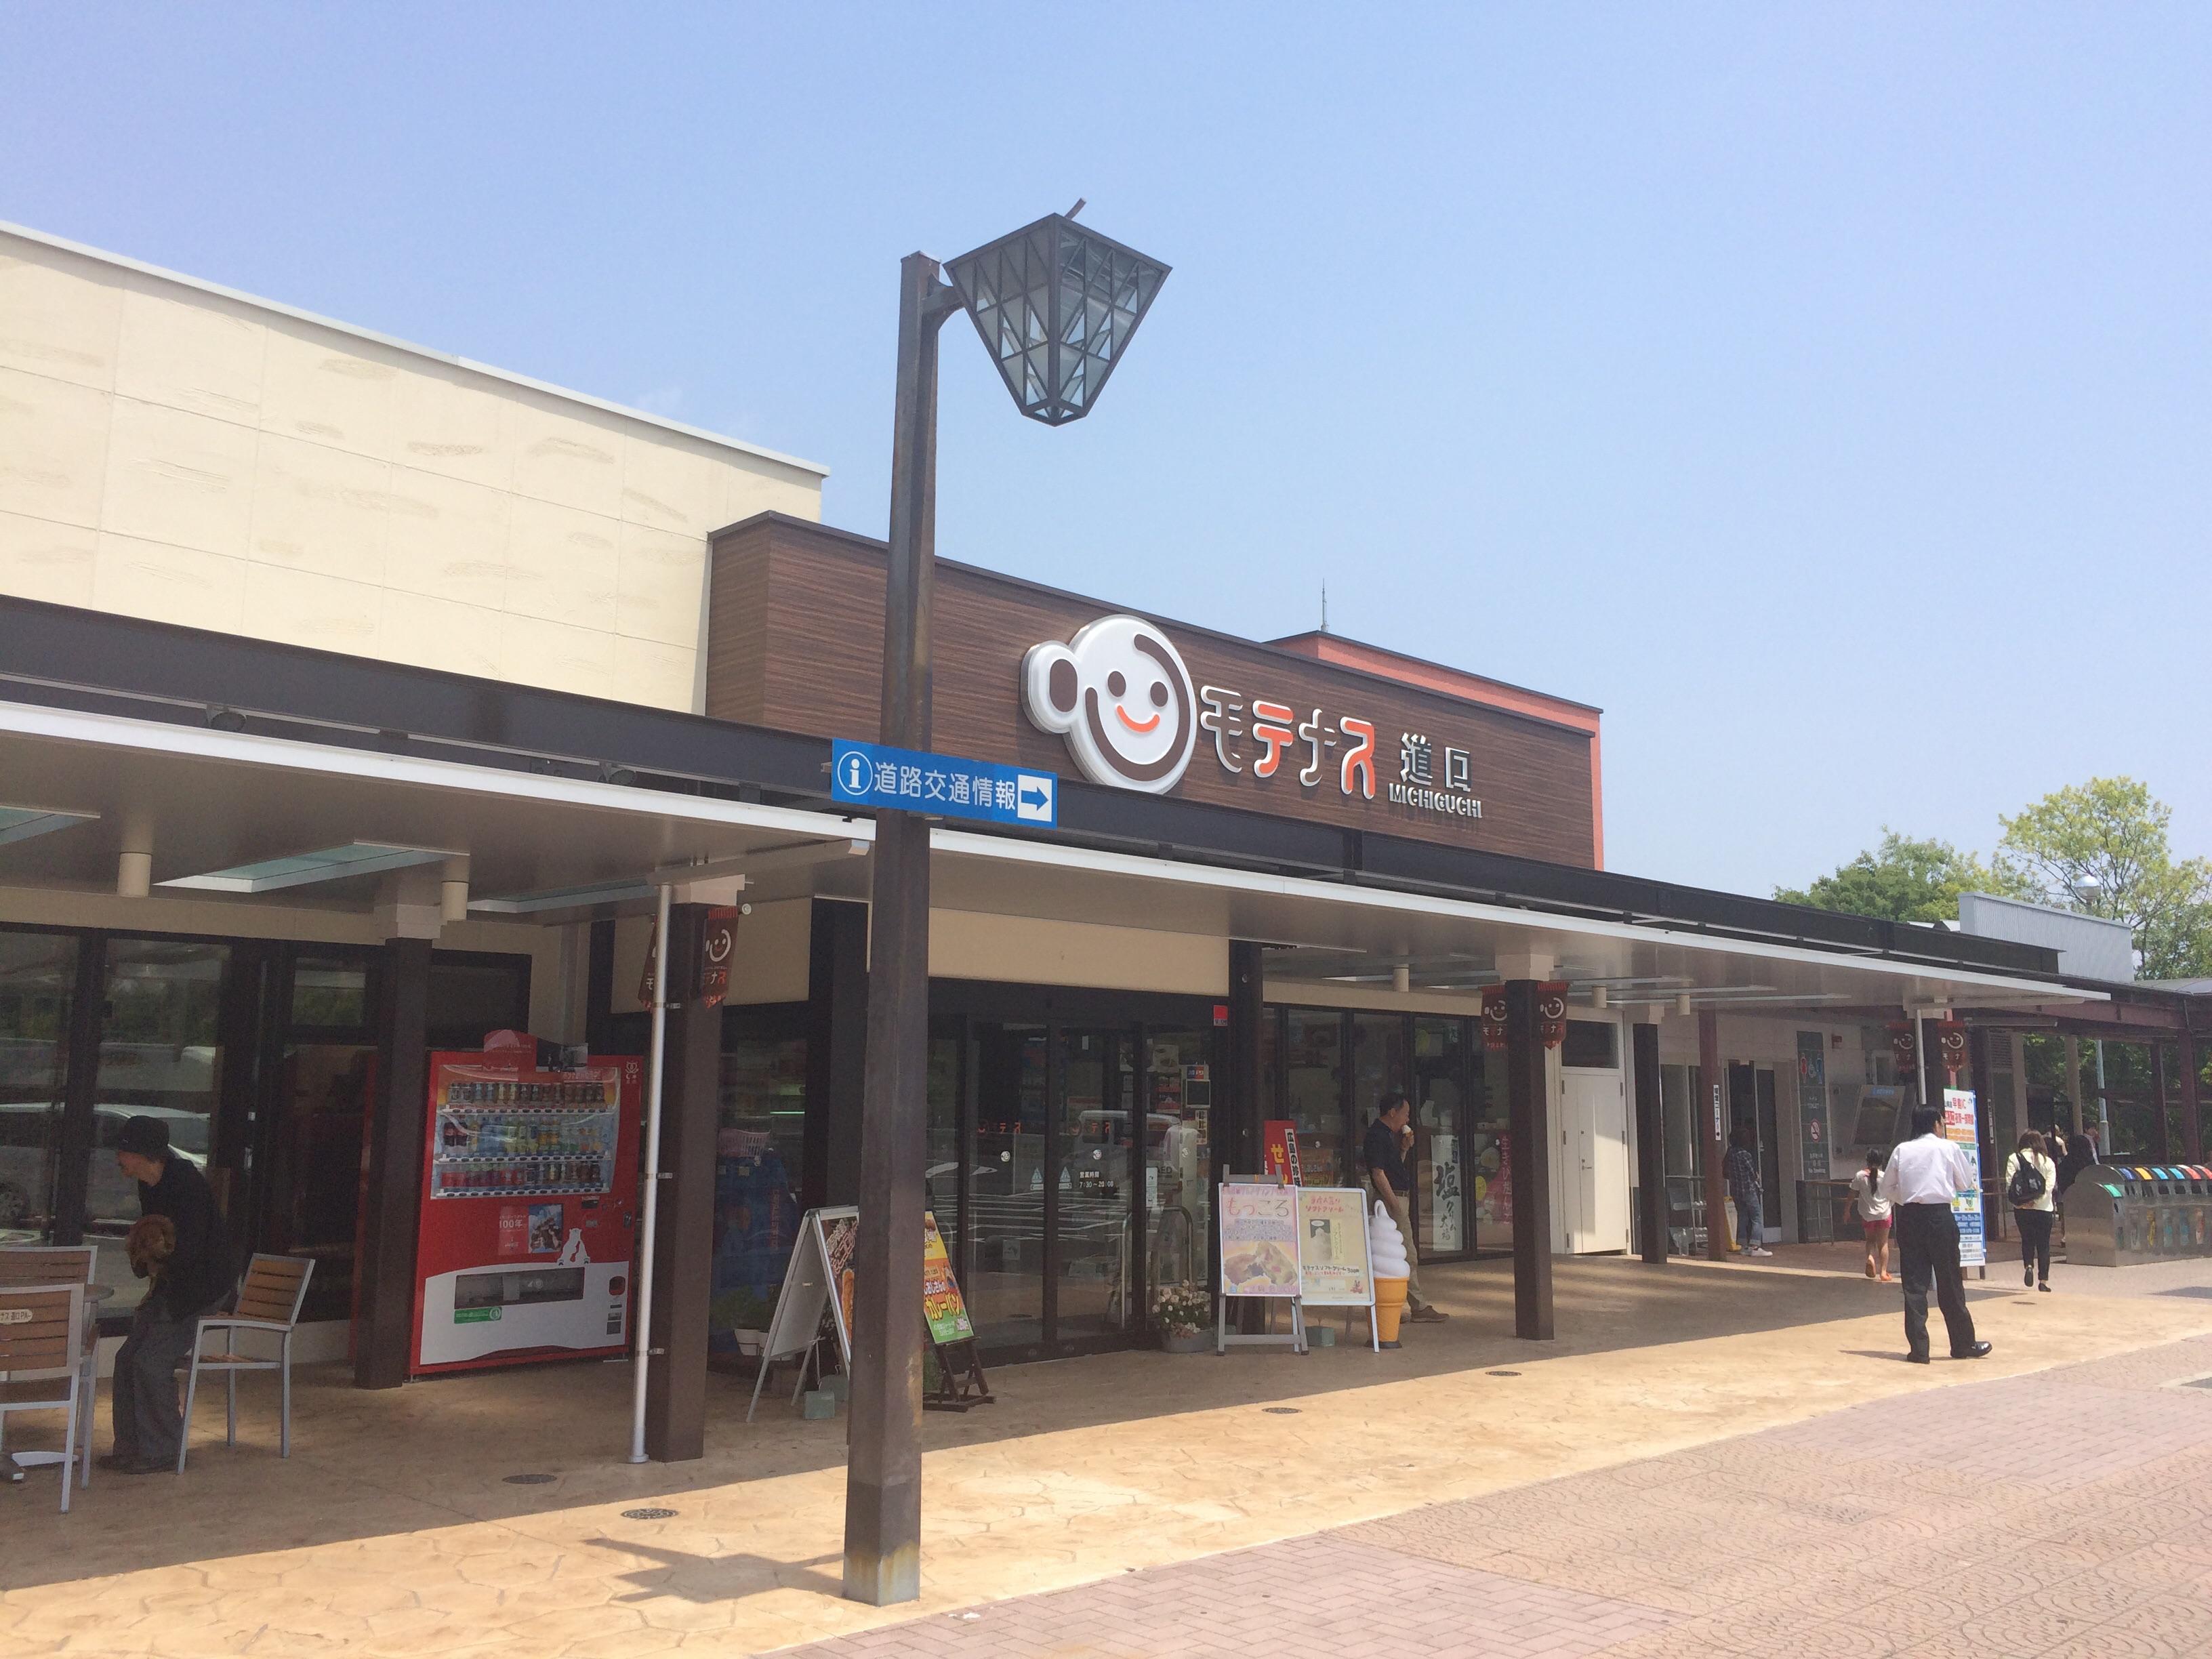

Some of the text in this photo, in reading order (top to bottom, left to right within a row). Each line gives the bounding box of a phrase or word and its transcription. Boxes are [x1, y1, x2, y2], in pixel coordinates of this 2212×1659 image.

[1200, 685, 1376, 800] モテナス
[1400, 733, 1473, 792] 道口
[874, 761, 1016, 811] 道路交通情報
[1434, 1161, 1460, 1200] 塩
[1226, 1197, 1290, 1218] もっころ
